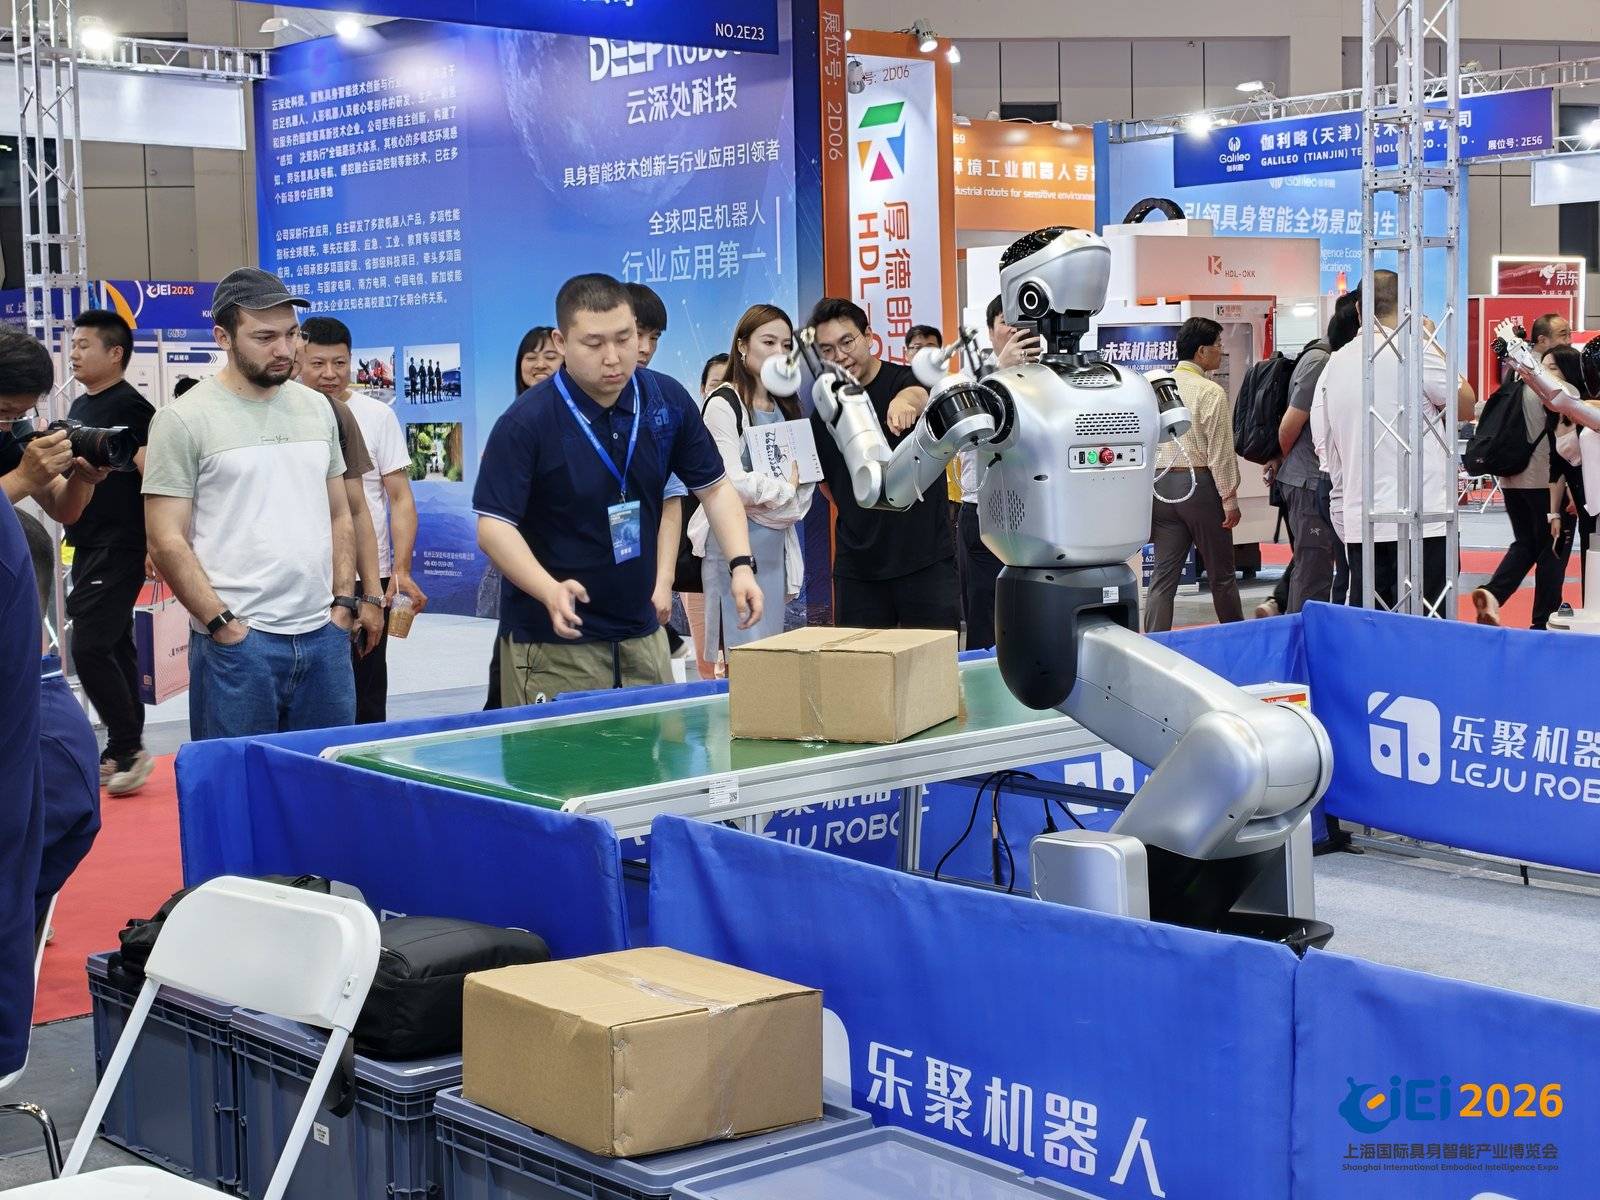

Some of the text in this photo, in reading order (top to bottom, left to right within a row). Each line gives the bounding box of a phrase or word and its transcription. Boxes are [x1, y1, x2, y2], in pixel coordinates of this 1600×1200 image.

[715, 23, 765, 41] NO.2E23
[626, 73, 737, 125] 云深处科技
[1219, 152, 1251, 164] Galileo
[1261, 156, 1299, 167] GALILEO
[1304, 149, 1348, 164] (TIANJIN)
[1487, 136, 1543, 151] 展位号：2E56
[562, 138, 781, 188] 具身智能技术创新与行业应用引领者
[953, 157, 1096, 182] 环境工业机器人专
[648, 200, 766, 236] 全球四足机器人
[1184, 203, 1400, 237] 引领具身智能全场景应生
[621, 240, 767, 285] 行业应用第一
[1556, 270, 1580, 287] 京东
[171, 286, 195, 295] 2026
[1450, 715, 1600, 770] 乐聚机器
[1450, 758, 1527, 794] LEJU
[866, 1040, 1167, 1199] 乐聚机器人
